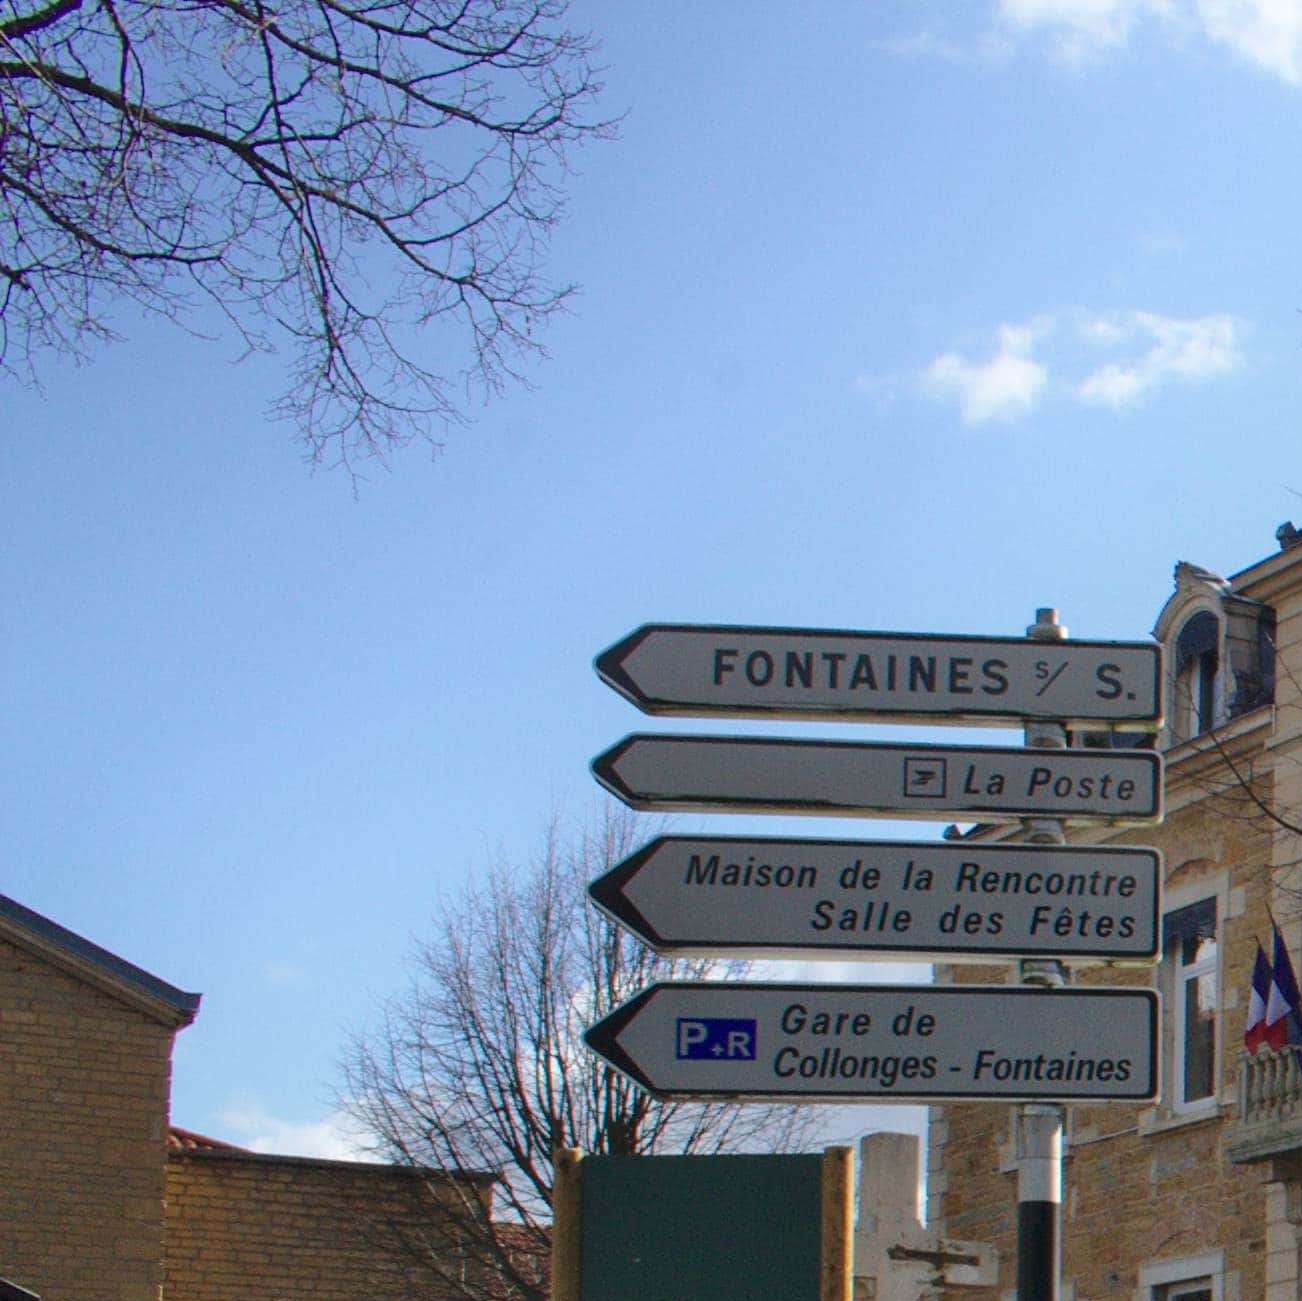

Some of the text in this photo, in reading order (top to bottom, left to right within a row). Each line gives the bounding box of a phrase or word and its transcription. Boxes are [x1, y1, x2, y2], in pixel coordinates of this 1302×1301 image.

[712, 648, 1010, 696] FONTAINES
[1095, 663, 1137, 701] S.
[963, 764, 1136, 801] La Poste
[684, 854, 1138, 898] Maison de la Rencontre
[810, 900, 1136, 939] Salle des Fêtes
[779, 1003, 937, 1037] Gare de
[772, 1046, 938, 1087] Collonges
[971, 1050, 1133, 1083] Fontaines
